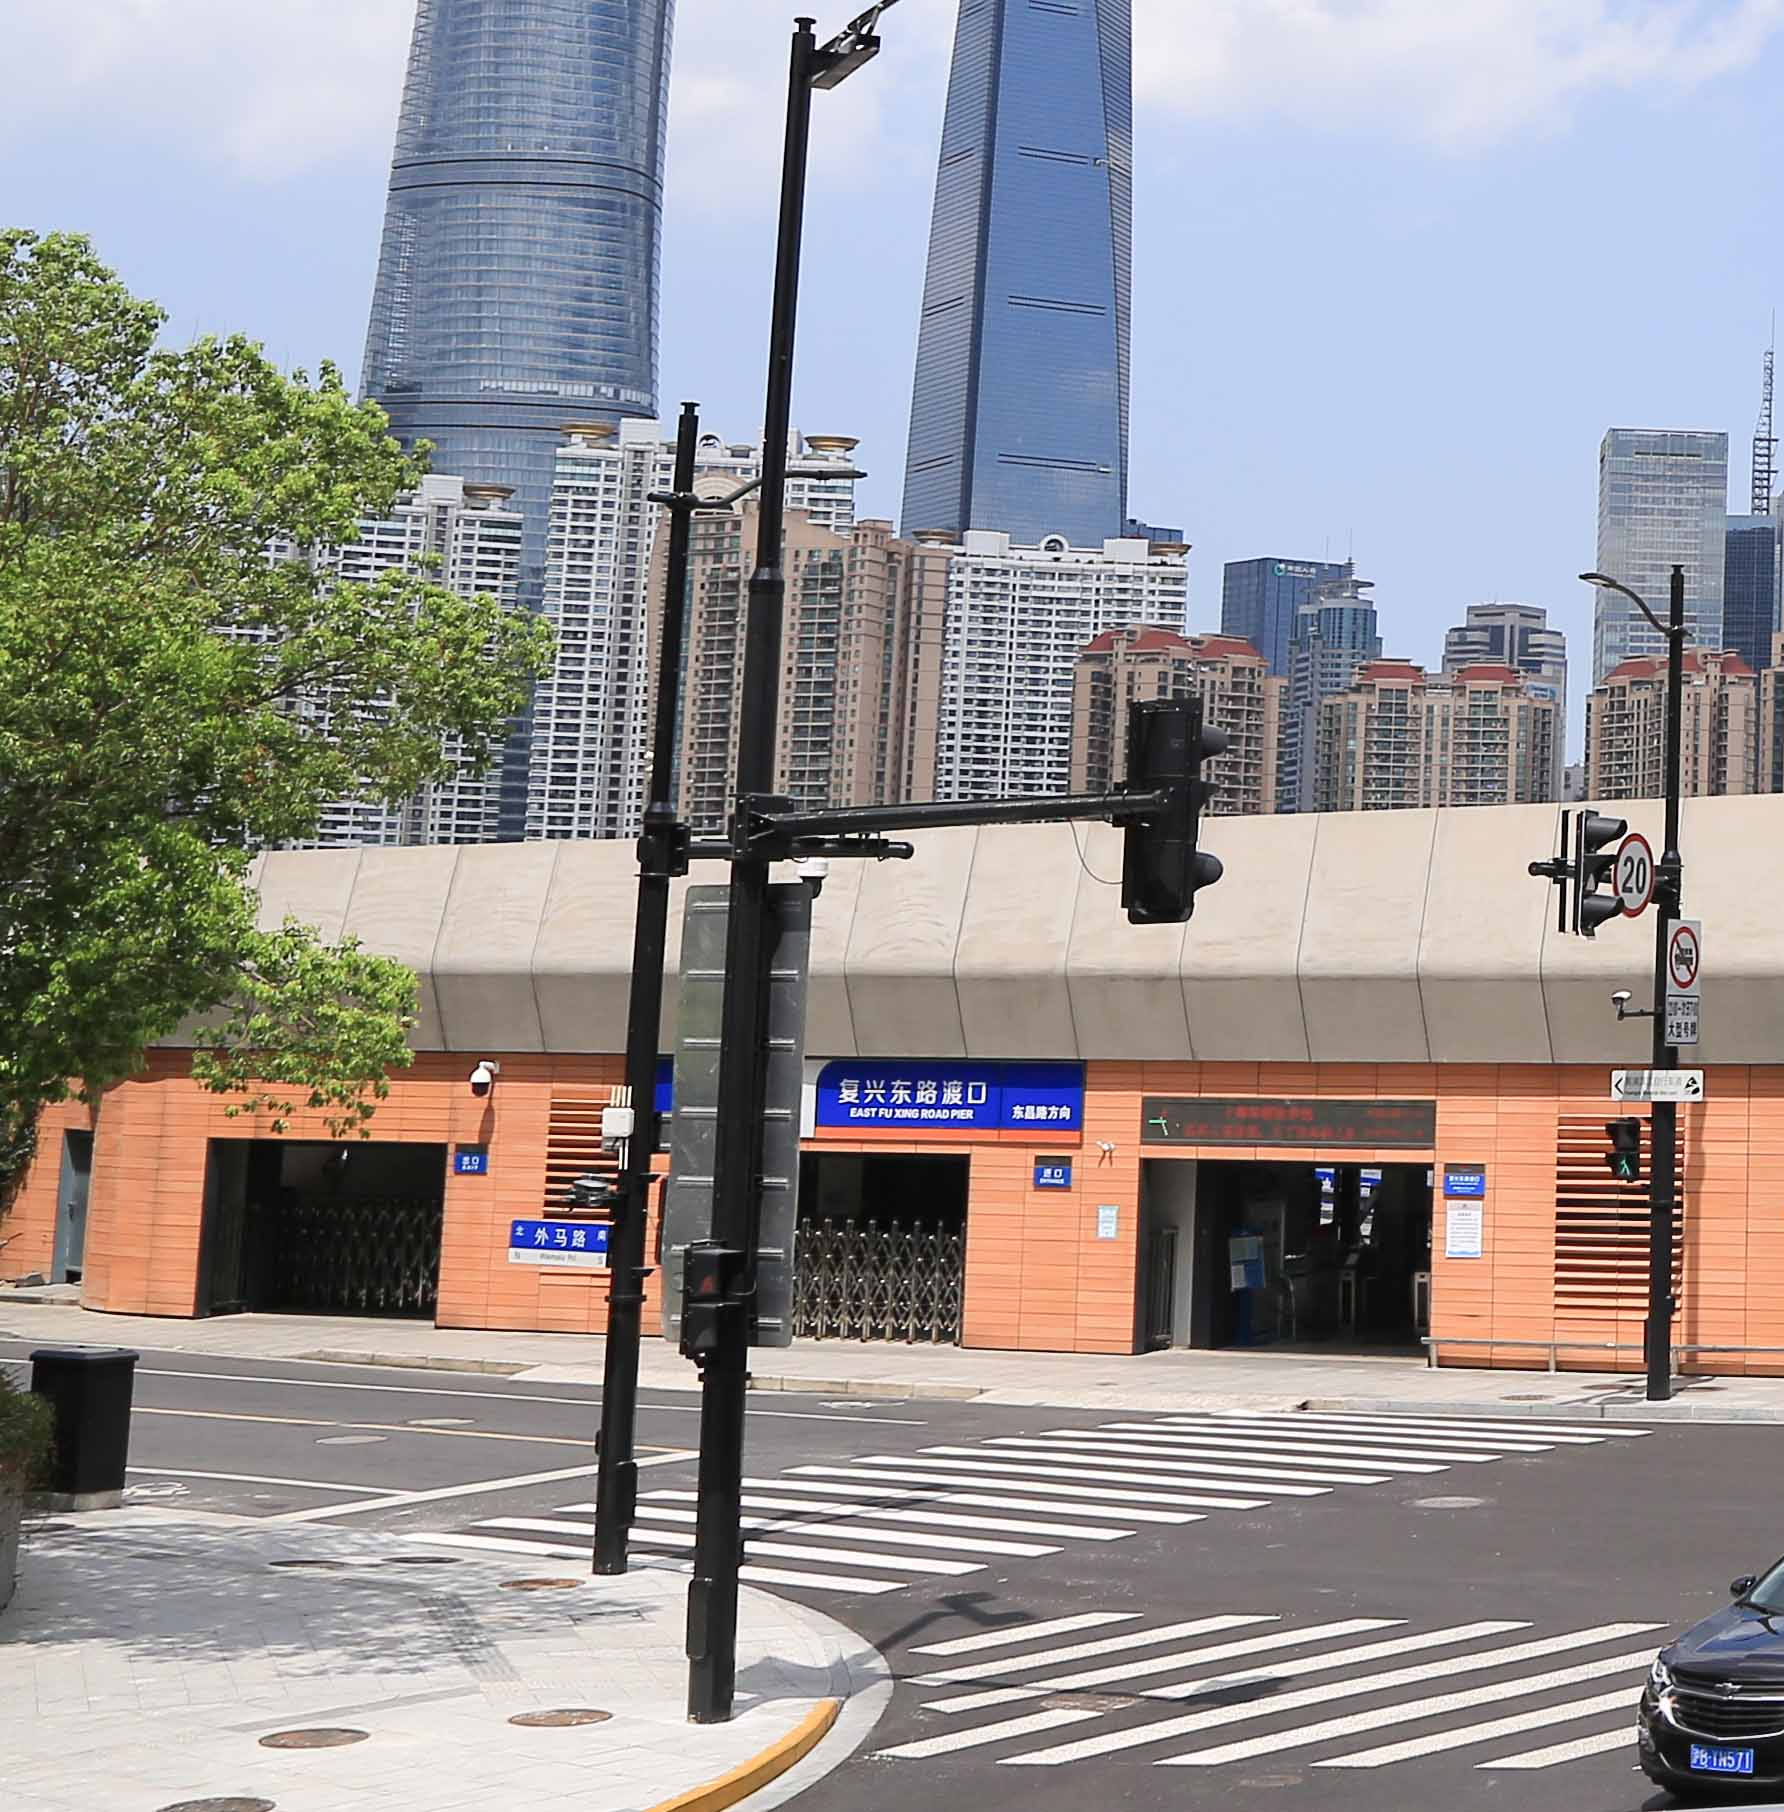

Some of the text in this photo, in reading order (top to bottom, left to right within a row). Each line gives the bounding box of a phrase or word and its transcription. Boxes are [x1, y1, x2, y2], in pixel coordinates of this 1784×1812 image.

[1622, 857, 1647, 894] 20
[838, 1078, 987, 1105] 复兴东路渡口
[850, 1107, 973, 1119] EAST FU XING ROAD PIER
[1012, 1105, 1071, 1120] 东昌路方向
[534, 1227, 586, 1248] 外马路
